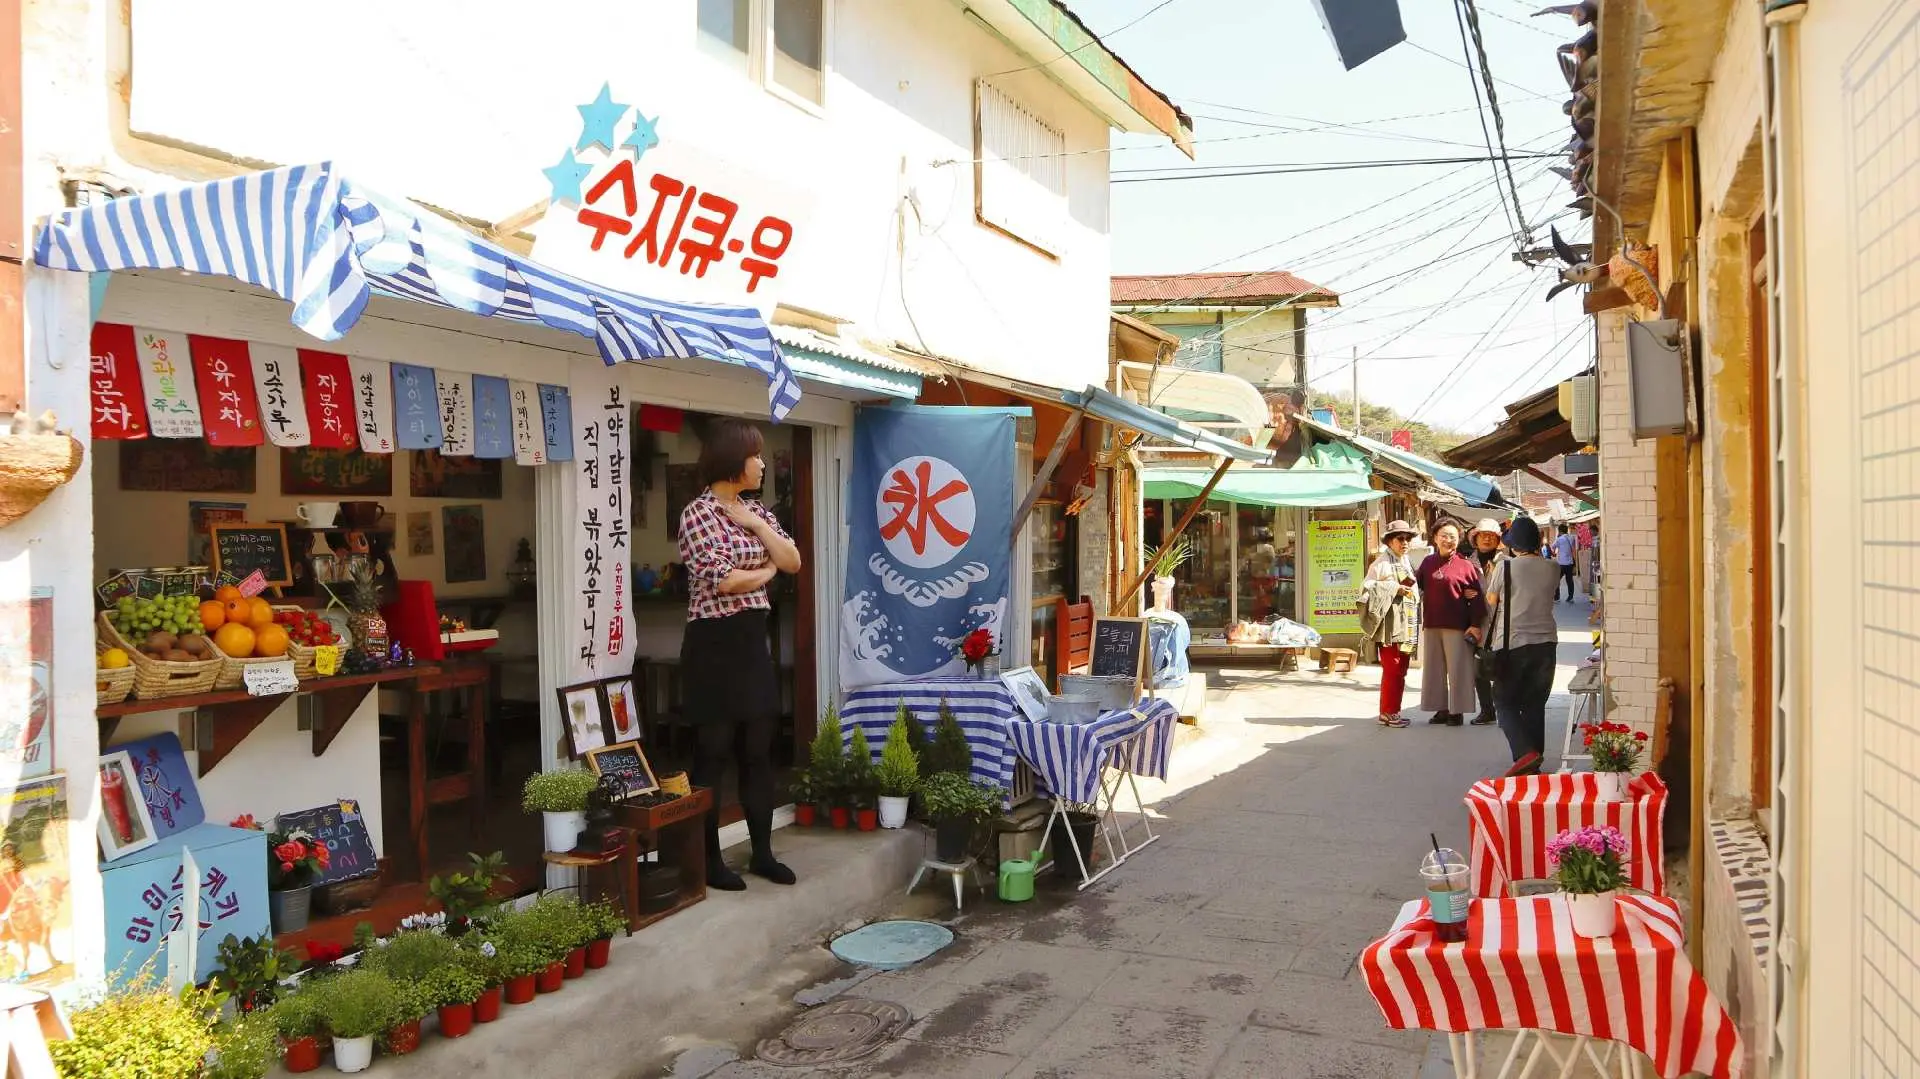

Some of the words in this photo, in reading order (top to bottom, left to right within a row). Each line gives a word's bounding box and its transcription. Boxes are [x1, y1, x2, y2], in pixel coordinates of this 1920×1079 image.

[90, 352, 132, 430] 레몬차
[211, 358, 243, 428] 유자차
[263, 361, 292, 432] 미숫가루
[317, 374, 342, 434] 자몽차
[360, 371, 377, 436] 옛날커피
[406, 375, 425, 434] 아이스티
[514, 390, 531, 454] 아메리카노
[583, 421, 599, 488] 직접
[604, 385, 627, 548] 보약달이듯
[880, 461, 970, 556] 氷
[1100, 625, 1134, 645] 오늘의
[1104, 643, 1129, 655] 커피
